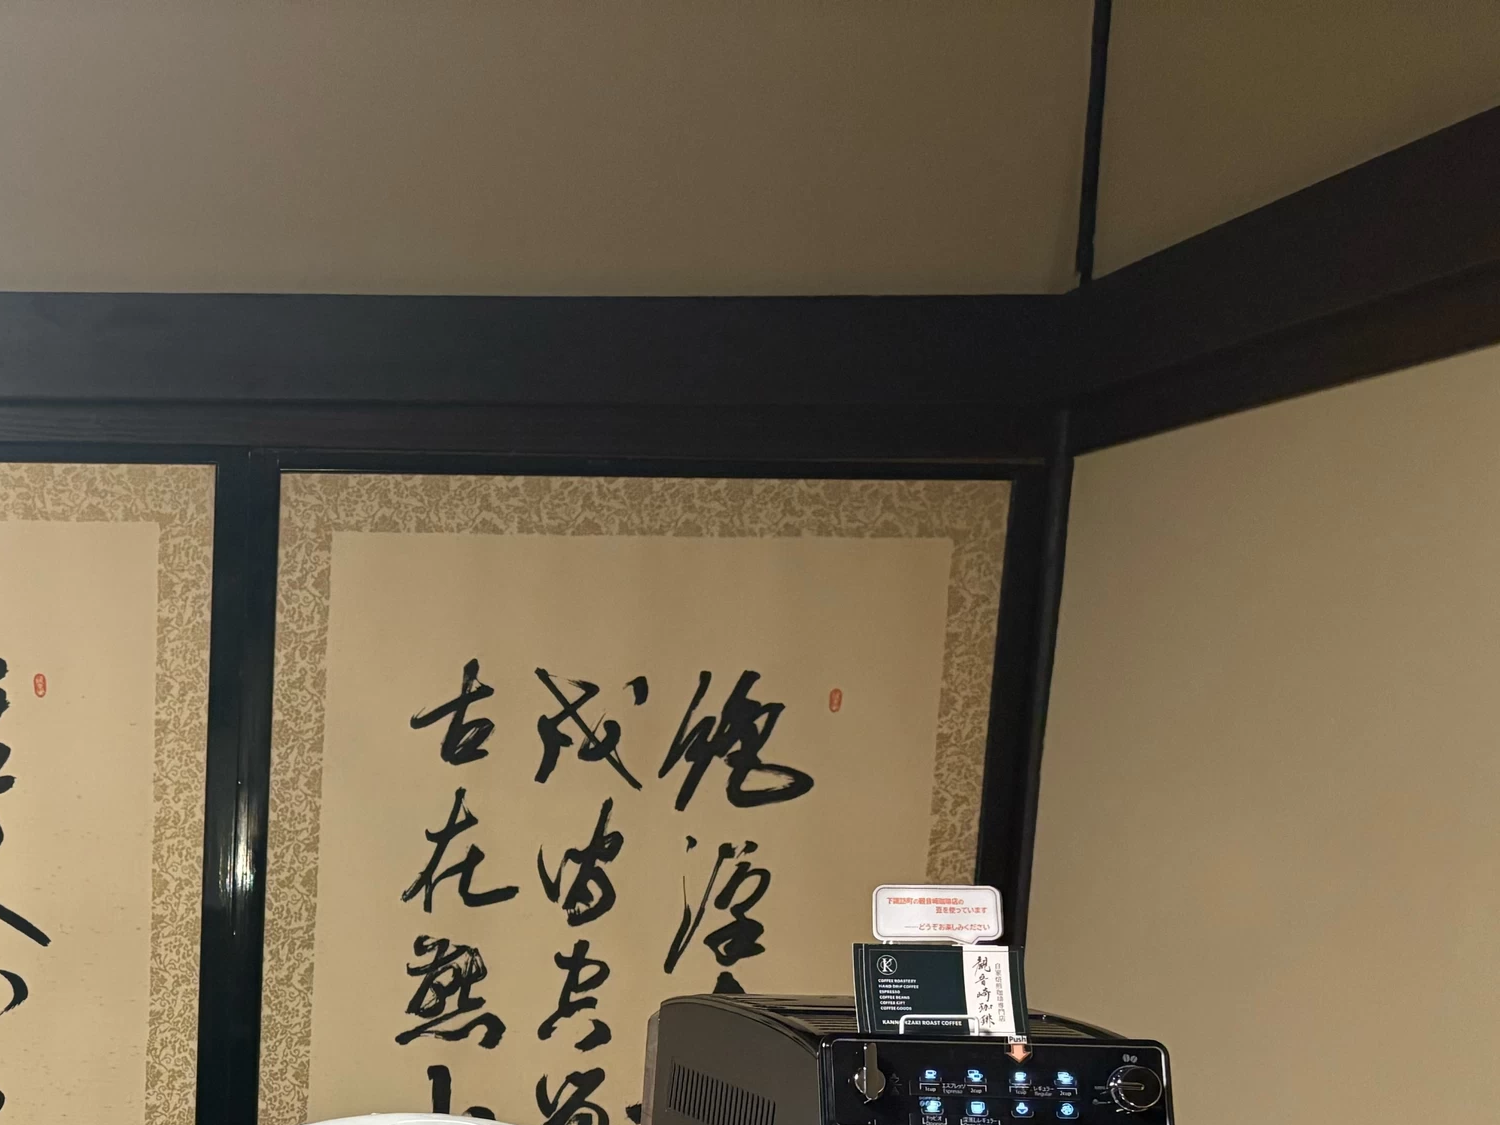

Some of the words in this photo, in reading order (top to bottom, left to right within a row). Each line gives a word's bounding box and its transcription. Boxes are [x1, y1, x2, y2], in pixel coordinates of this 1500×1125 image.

[936, 906, 987, 914] 豆を使っています
